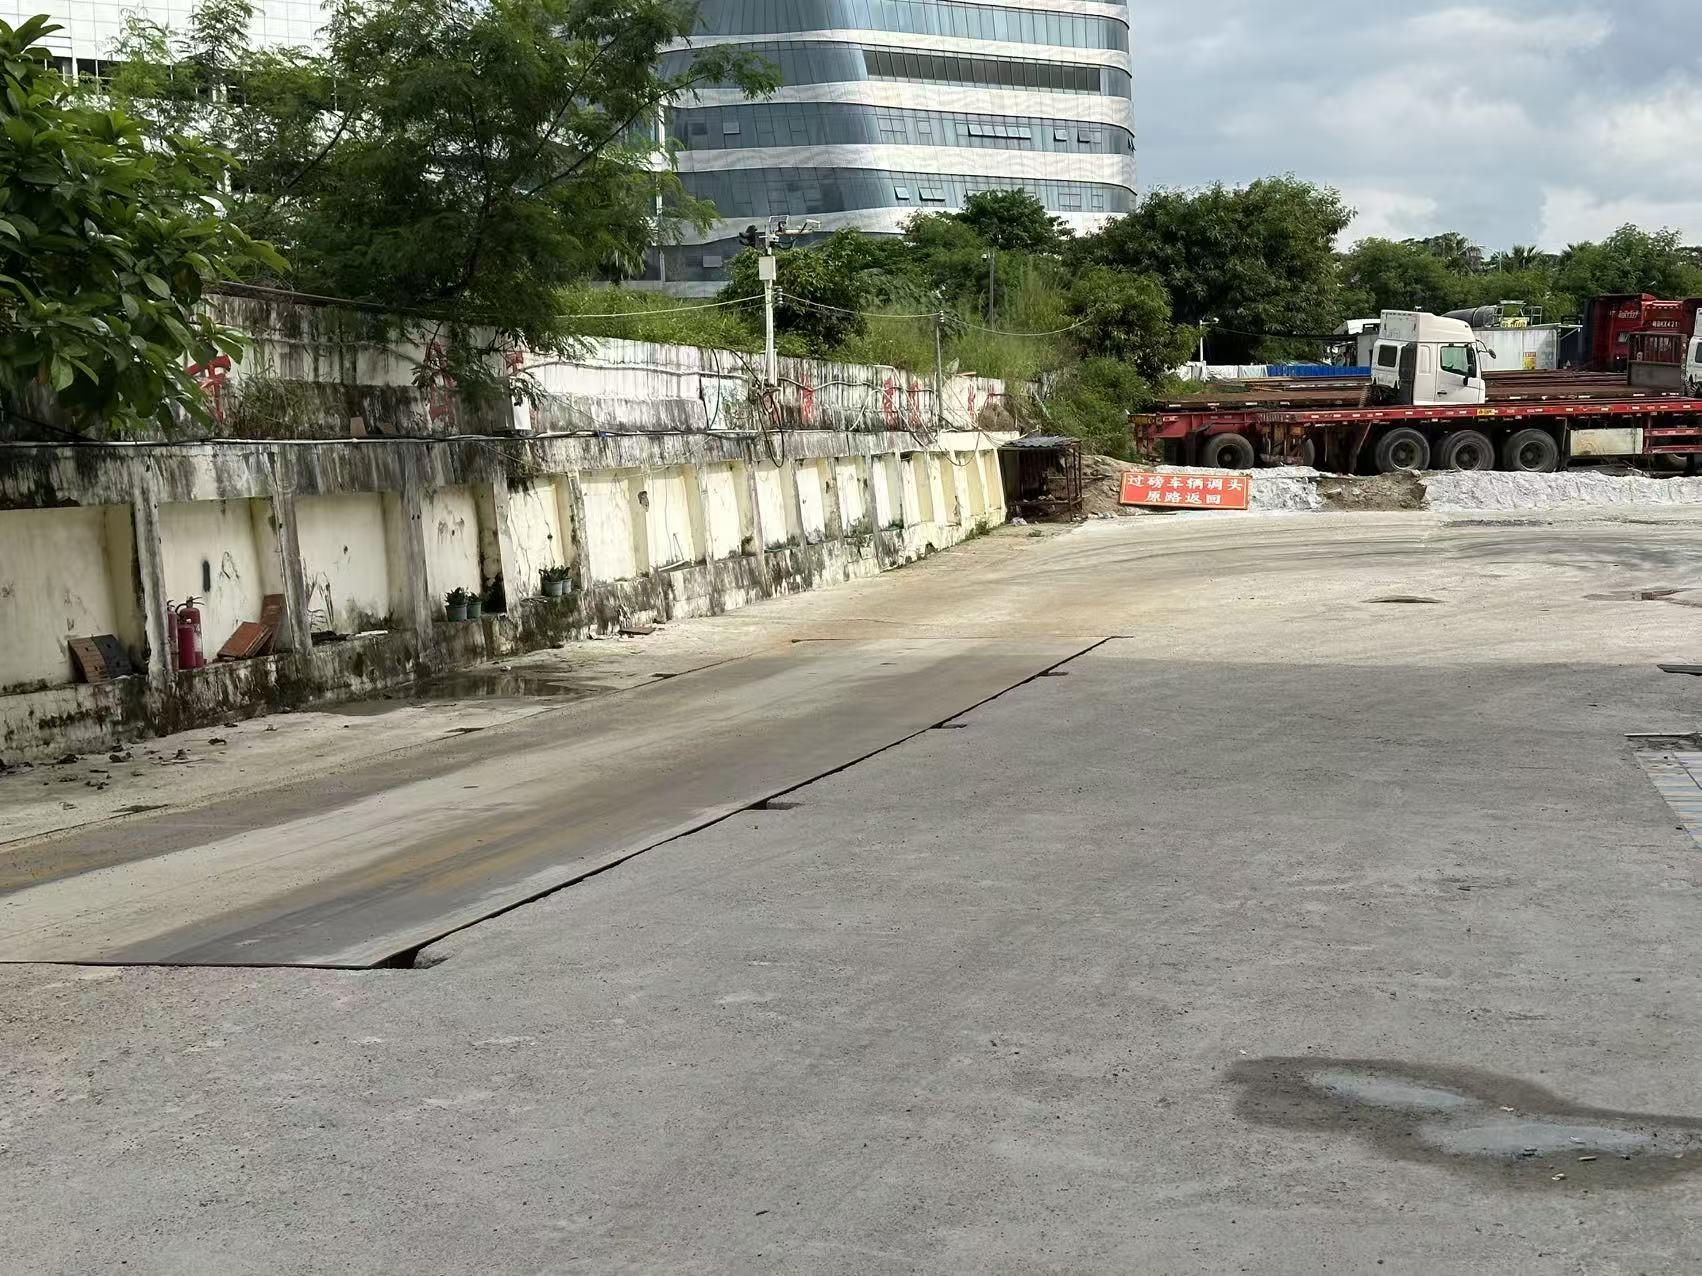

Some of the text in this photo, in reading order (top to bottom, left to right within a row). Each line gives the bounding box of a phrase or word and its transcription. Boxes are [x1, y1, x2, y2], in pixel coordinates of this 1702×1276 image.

[1128, 475, 1243, 491] 过磅车辆调头
[1144, 490, 1222, 505] 原路返回
